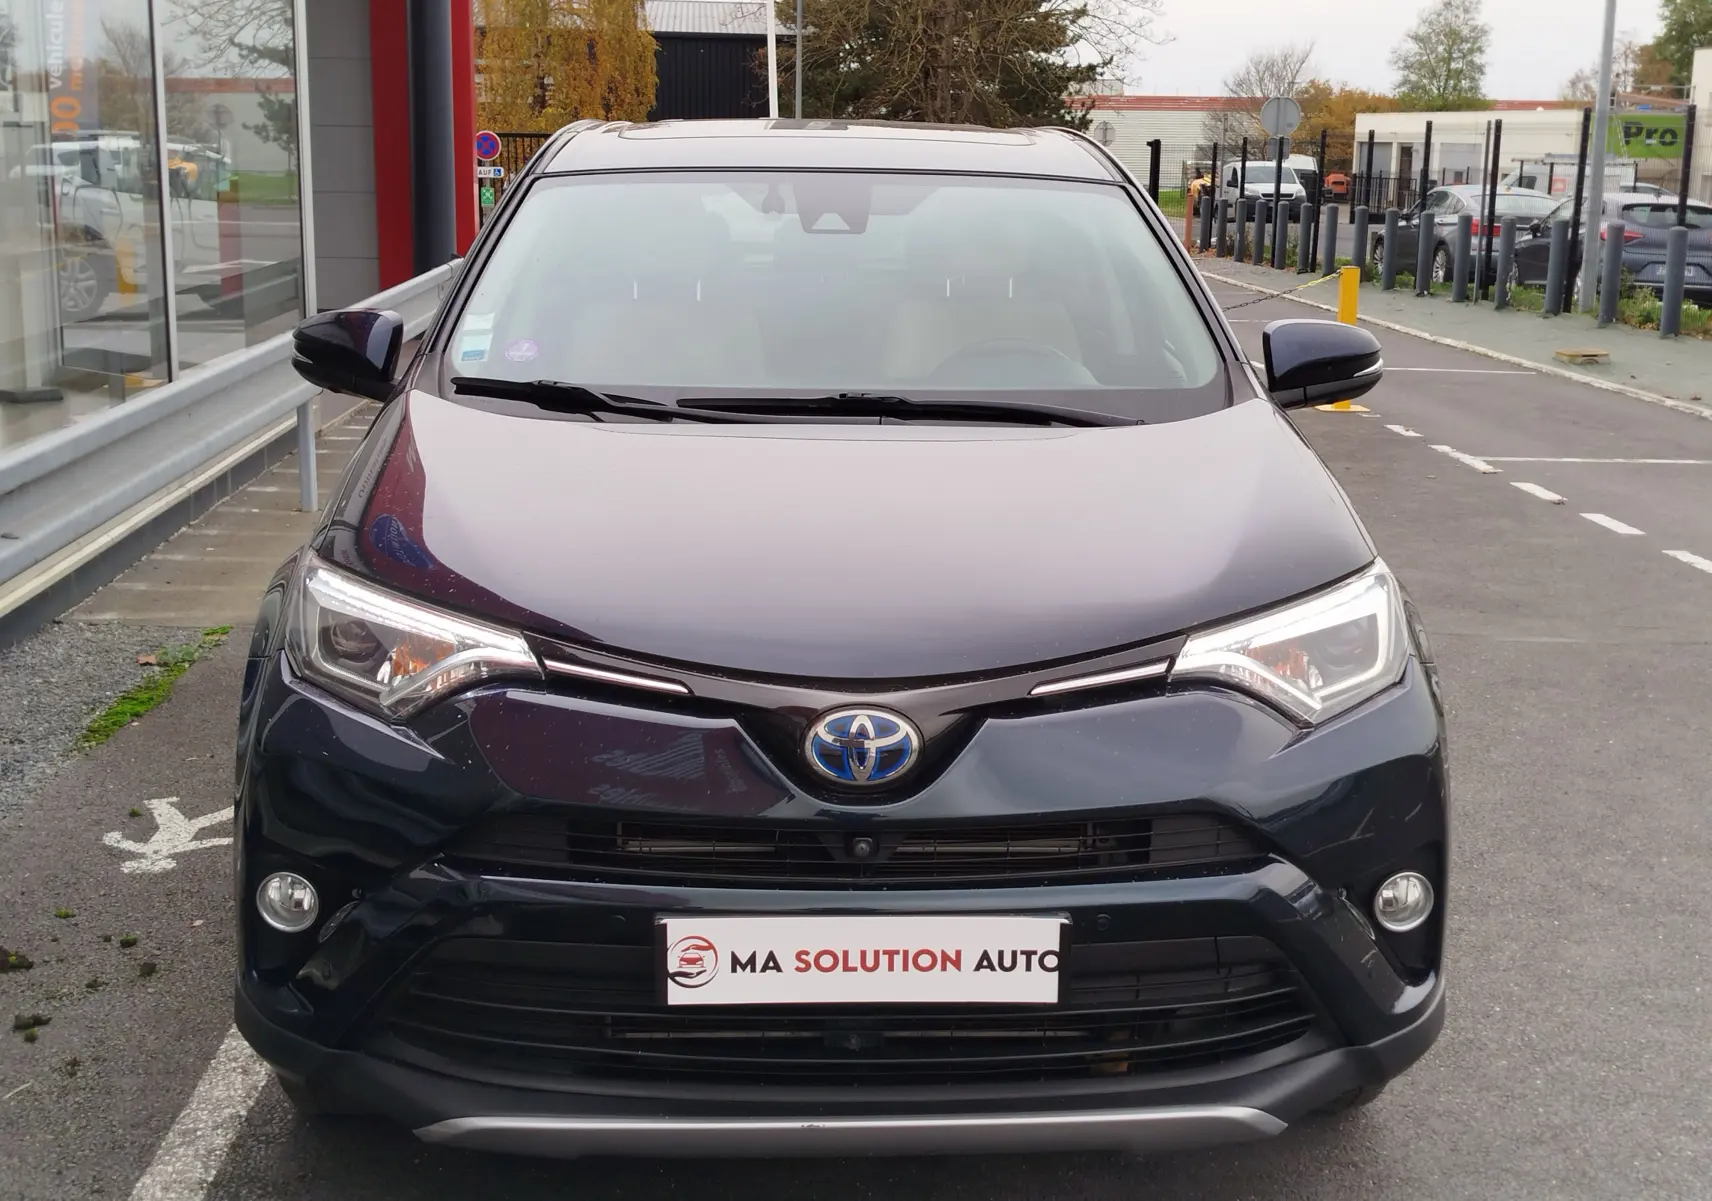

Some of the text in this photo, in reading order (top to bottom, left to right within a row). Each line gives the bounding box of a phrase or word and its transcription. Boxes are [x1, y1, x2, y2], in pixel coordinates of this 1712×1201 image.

[1623, 121, 1678, 146] Pro
[730, 949, 1060, 974] MA SOLUTION AUTO
